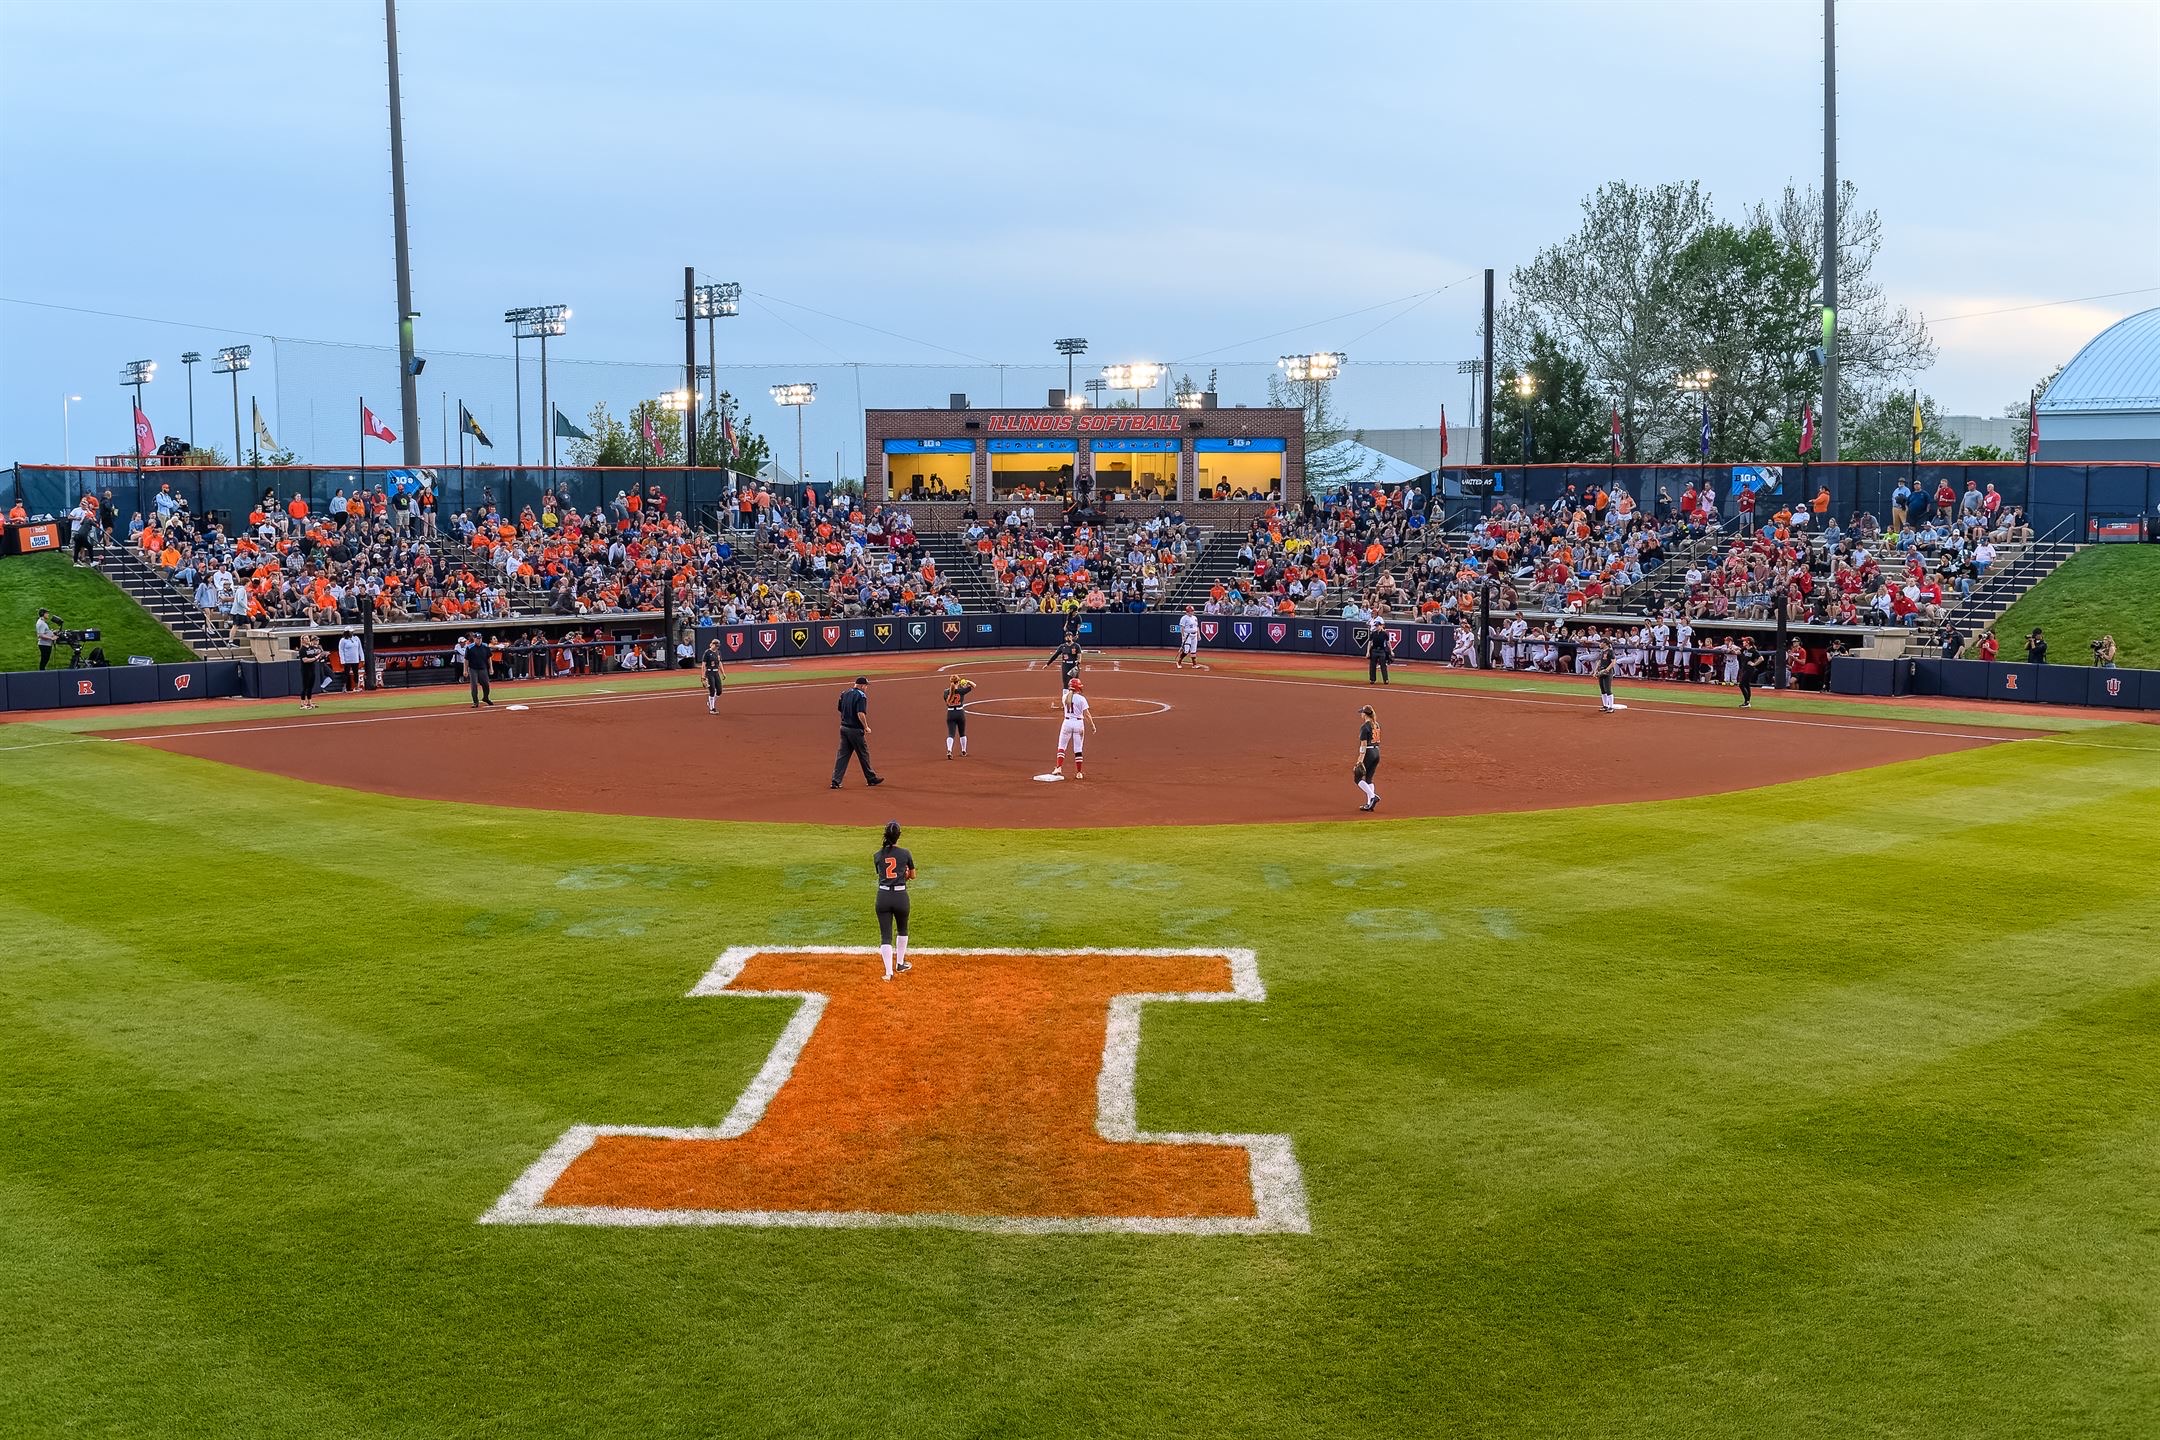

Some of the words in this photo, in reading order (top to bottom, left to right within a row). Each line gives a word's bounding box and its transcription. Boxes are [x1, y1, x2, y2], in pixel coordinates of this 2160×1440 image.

[987, 415, 1073, 431] ILLINOIS
[1077, 415, 1182, 431] SOFTBALL
[827, 628, 836, 639] M
[877, 626, 889, 636] M
[1205, 624, 1214, 634] N
[1240, 624, 1247, 636] N
[1355, 630, 1368, 640] P
[731, 635, 738, 646] I
[1388, 631, 1397, 642] R
[1420, 633, 1431, 645] W
[78, 680, 95, 695] R
[175, 674, 191, 691] W
[2006, 674, 2018, 689] I
[885, 857, 898, 879] 2
